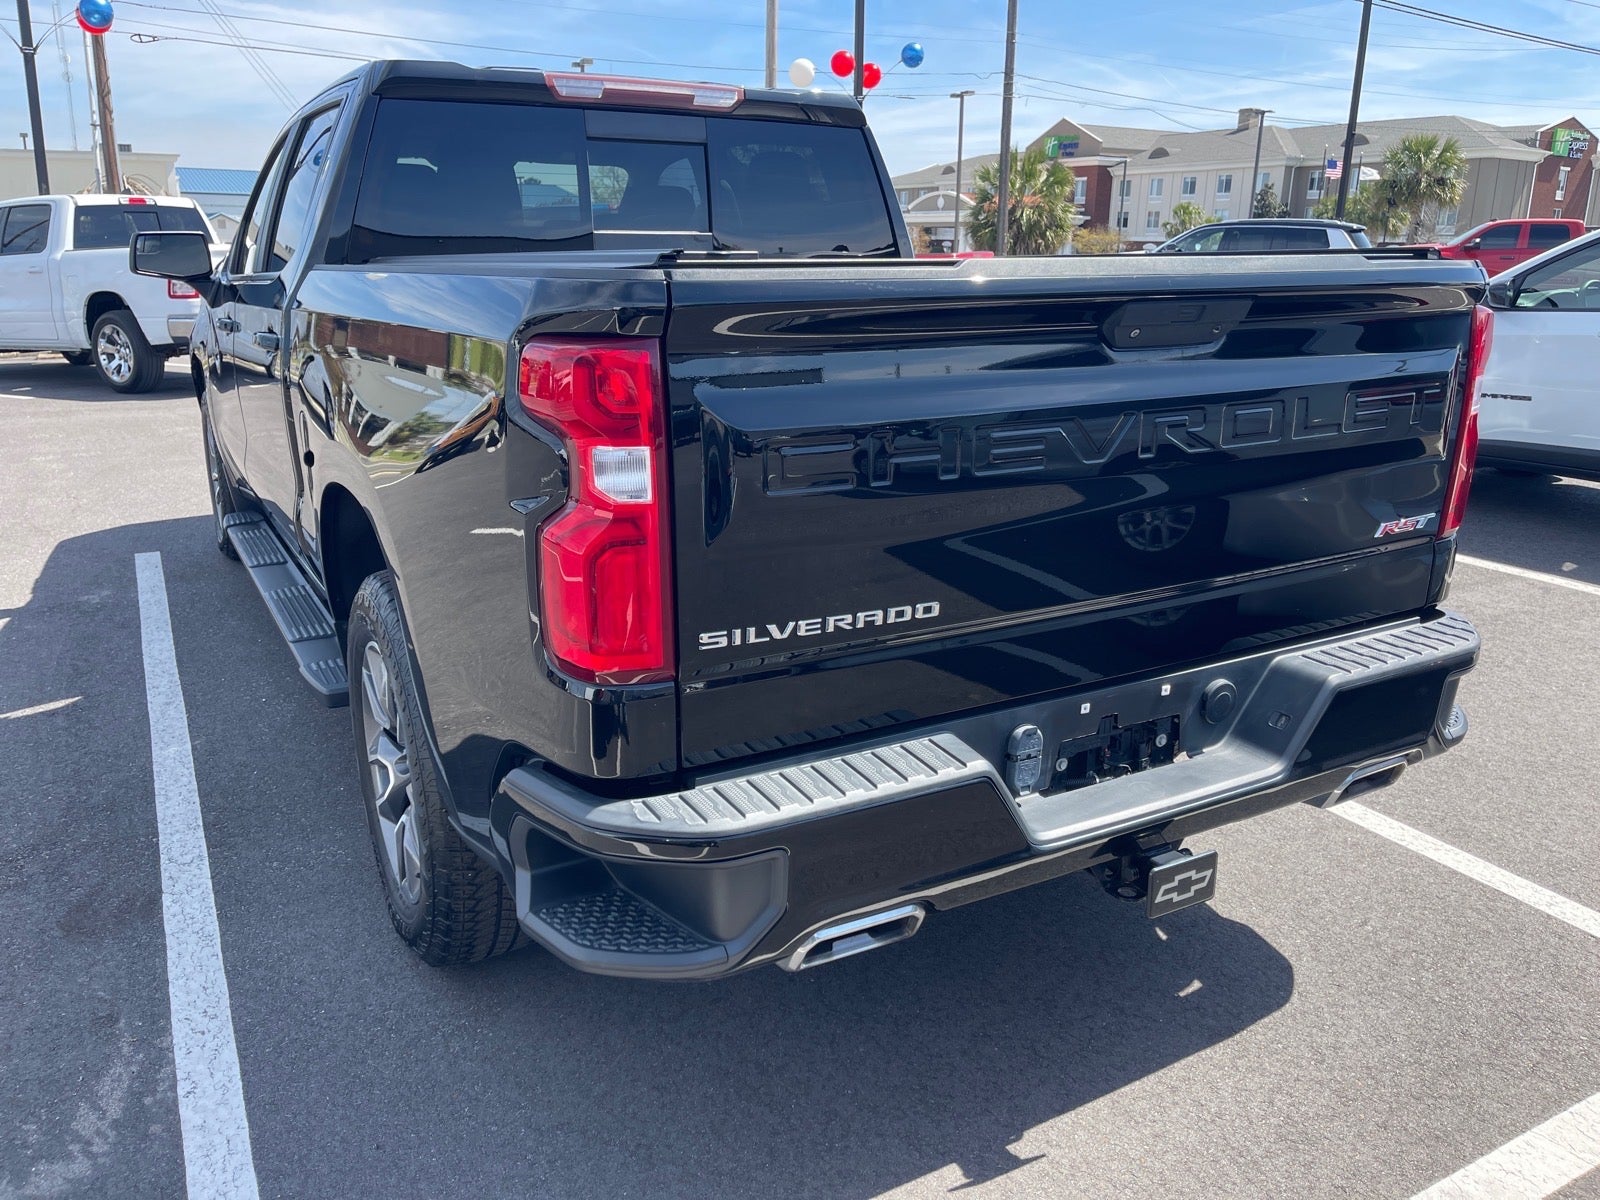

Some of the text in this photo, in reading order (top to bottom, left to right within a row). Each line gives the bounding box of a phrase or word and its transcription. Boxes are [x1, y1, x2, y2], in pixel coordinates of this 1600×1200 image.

[762, 382, 1442, 497] CHEVROLET
[1374, 513, 1436, 538] RST
[698, 601, 940, 650] SILVERADO
